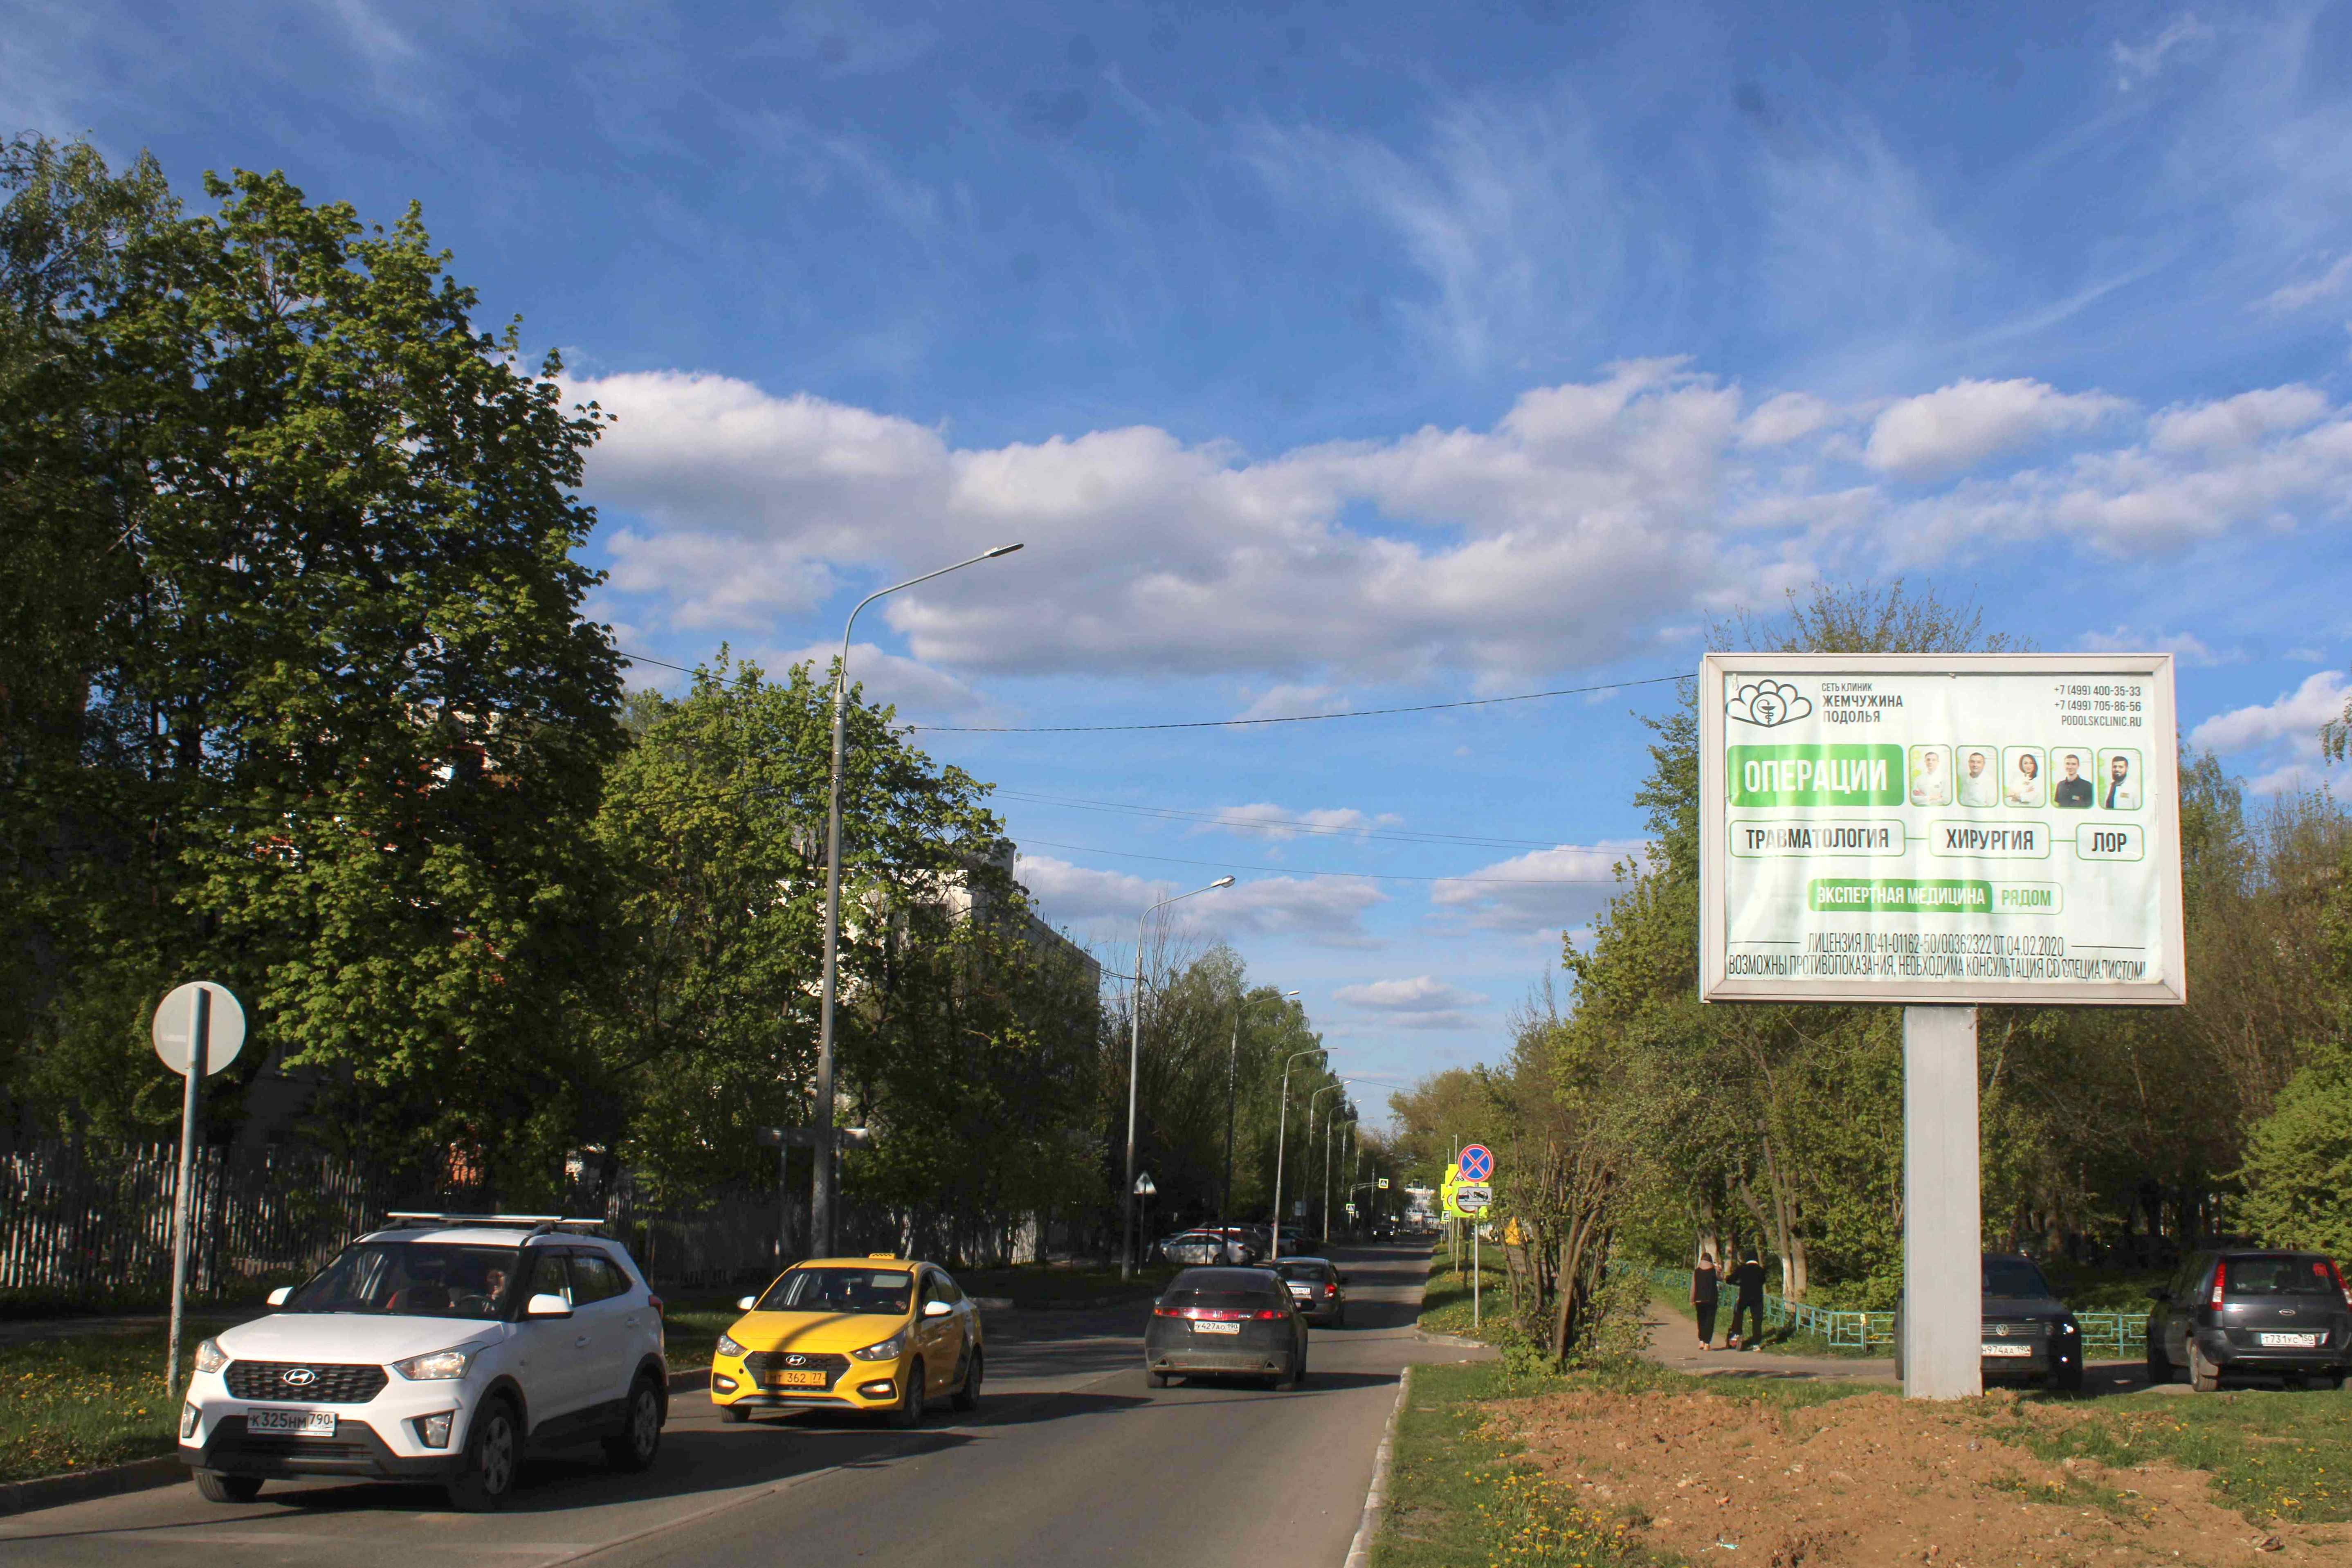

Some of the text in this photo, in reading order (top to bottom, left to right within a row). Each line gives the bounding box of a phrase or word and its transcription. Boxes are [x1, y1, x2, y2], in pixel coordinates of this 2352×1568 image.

[1822, 683, 1872, 692] СЕТЬ КЛИНИК
[2054, 685, 2141, 696] +7 (499) 400-35-33
[1822, 695, 1903, 707] ЖЕМЧУЖИНА
[2054, 700, 2141, 712] +7 (499) 705-86-56
[1823, 710, 1880, 724] ПОДОЛЬЯ
[2061, 715, 2142, 727] PODOLSKCLINIC.RU
[1744, 759, 1888, 794] ОПЕРАЦИИ
[1745, 828, 1889, 850] ТРАВМАТОЛОГИЯ
[1945, 828, 2033, 850] ХИРУРГИЯ
[2091, 832, 2127, 852] ЛОР
[1817, 886, 1986, 906] ЭКСПЕРТНАЯ МЕДИЦИНА
[2002, 889, 2052, 907] РЯДОМ
[1807, 932, 1862, 954] ЛИЦЕНЗИЯ
[1994, 935, 2004, 955] ОТ
[2007, 935, 2064, 957] 04.02.2020
[1728, 954, 2146, 982] ВОЗМОЖНЫ ПРОТИВОПОКАЗАНИЯ, НЕОБХОДИМА КОНСУЛЬТАЦИЯ СО СПЕЦИАЛИСТОМ!
[787, 1373, 806, 1383] 362
[812, 1373, 822, 1381] 77
[251, 1412, 330, 1428] К325НМ 790
